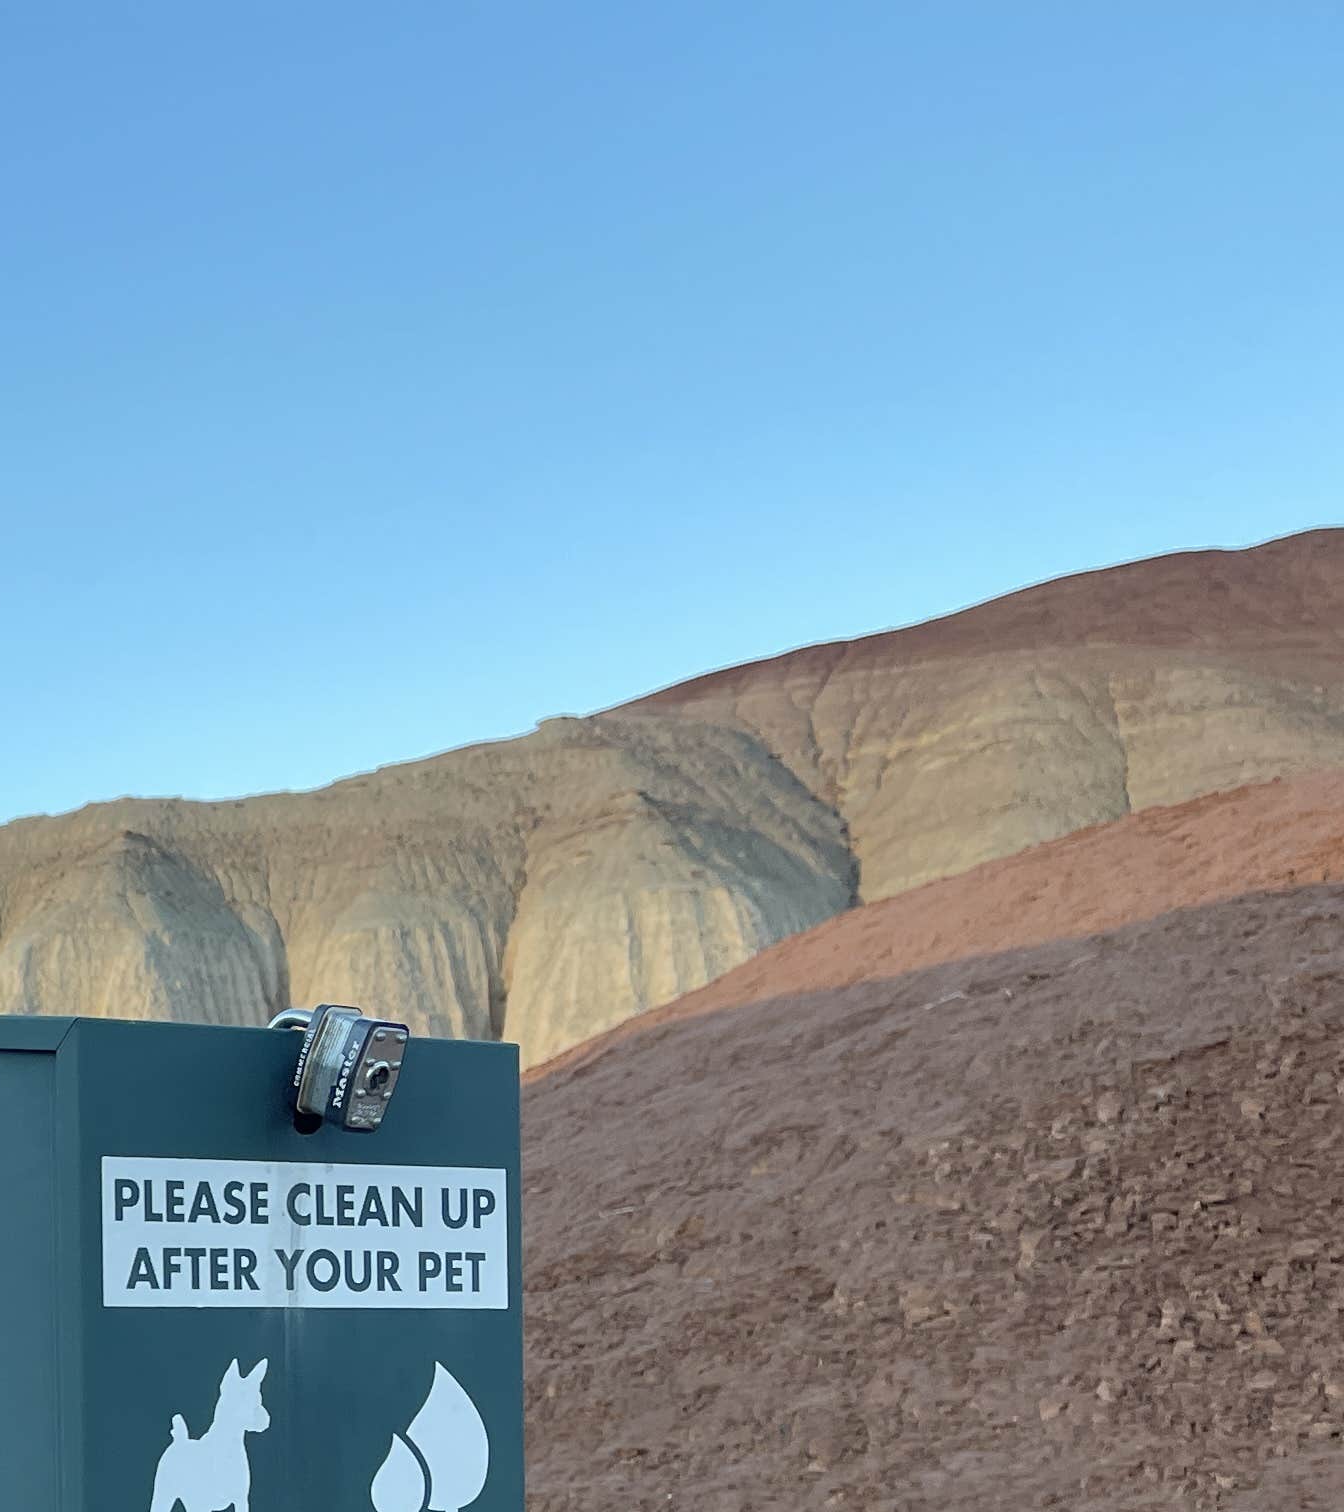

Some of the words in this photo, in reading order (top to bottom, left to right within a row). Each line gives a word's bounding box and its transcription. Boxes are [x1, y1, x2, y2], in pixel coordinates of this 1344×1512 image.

[293, 1028, 316, 1087] COMMERCIAL
[332, 1041, 360, 1109] Master
[113, 1178, 270, 1226] PLEASE
[286, 1182, 423, 1229] CLEAN
[440, 1187, 497, 1230] UP
[126, 1247, 261, 1291] AFTER
[274, 1248, 403, 1293] YOUR
[418, 1251, 487, 1293] PET
